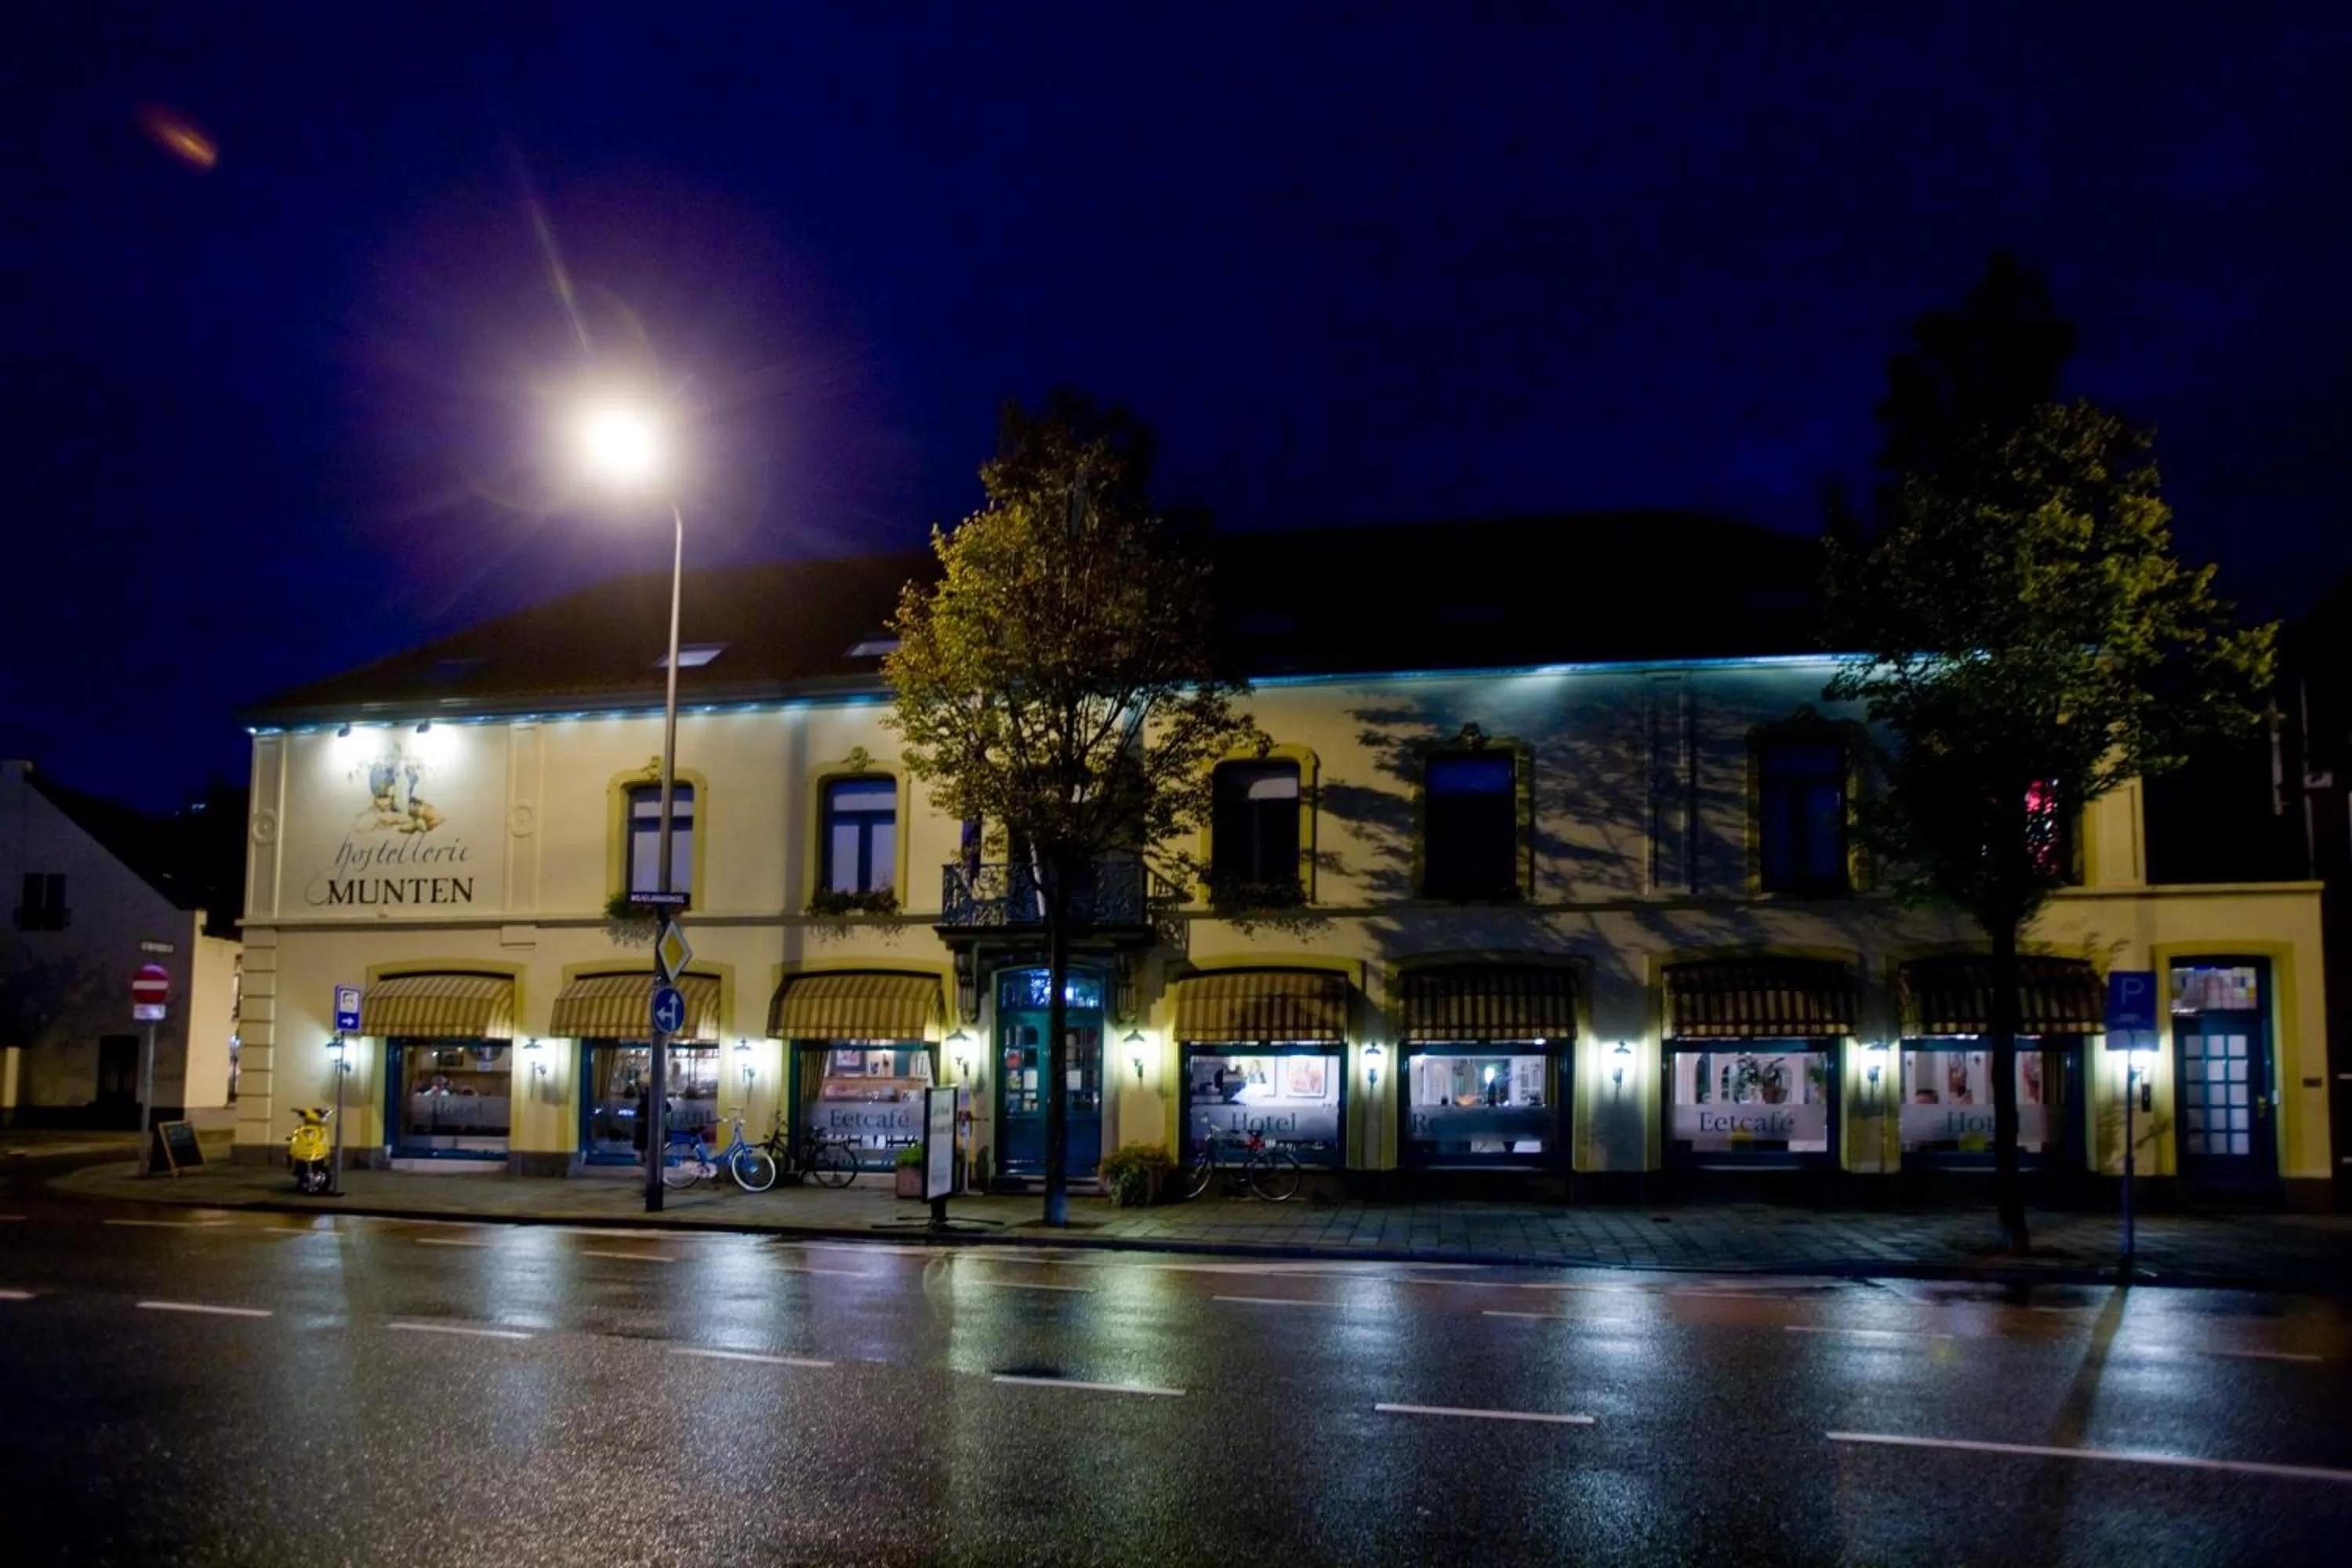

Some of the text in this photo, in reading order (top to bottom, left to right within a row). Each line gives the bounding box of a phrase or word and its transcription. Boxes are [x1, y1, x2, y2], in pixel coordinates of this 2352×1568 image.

[327, 877, 474, 904] MUNTEN
[2120, 978, 2146, 1005] P
[1231, 1112, 1296, 1132] Hotel
[1946, 1110, 1996, 1133] Hot
